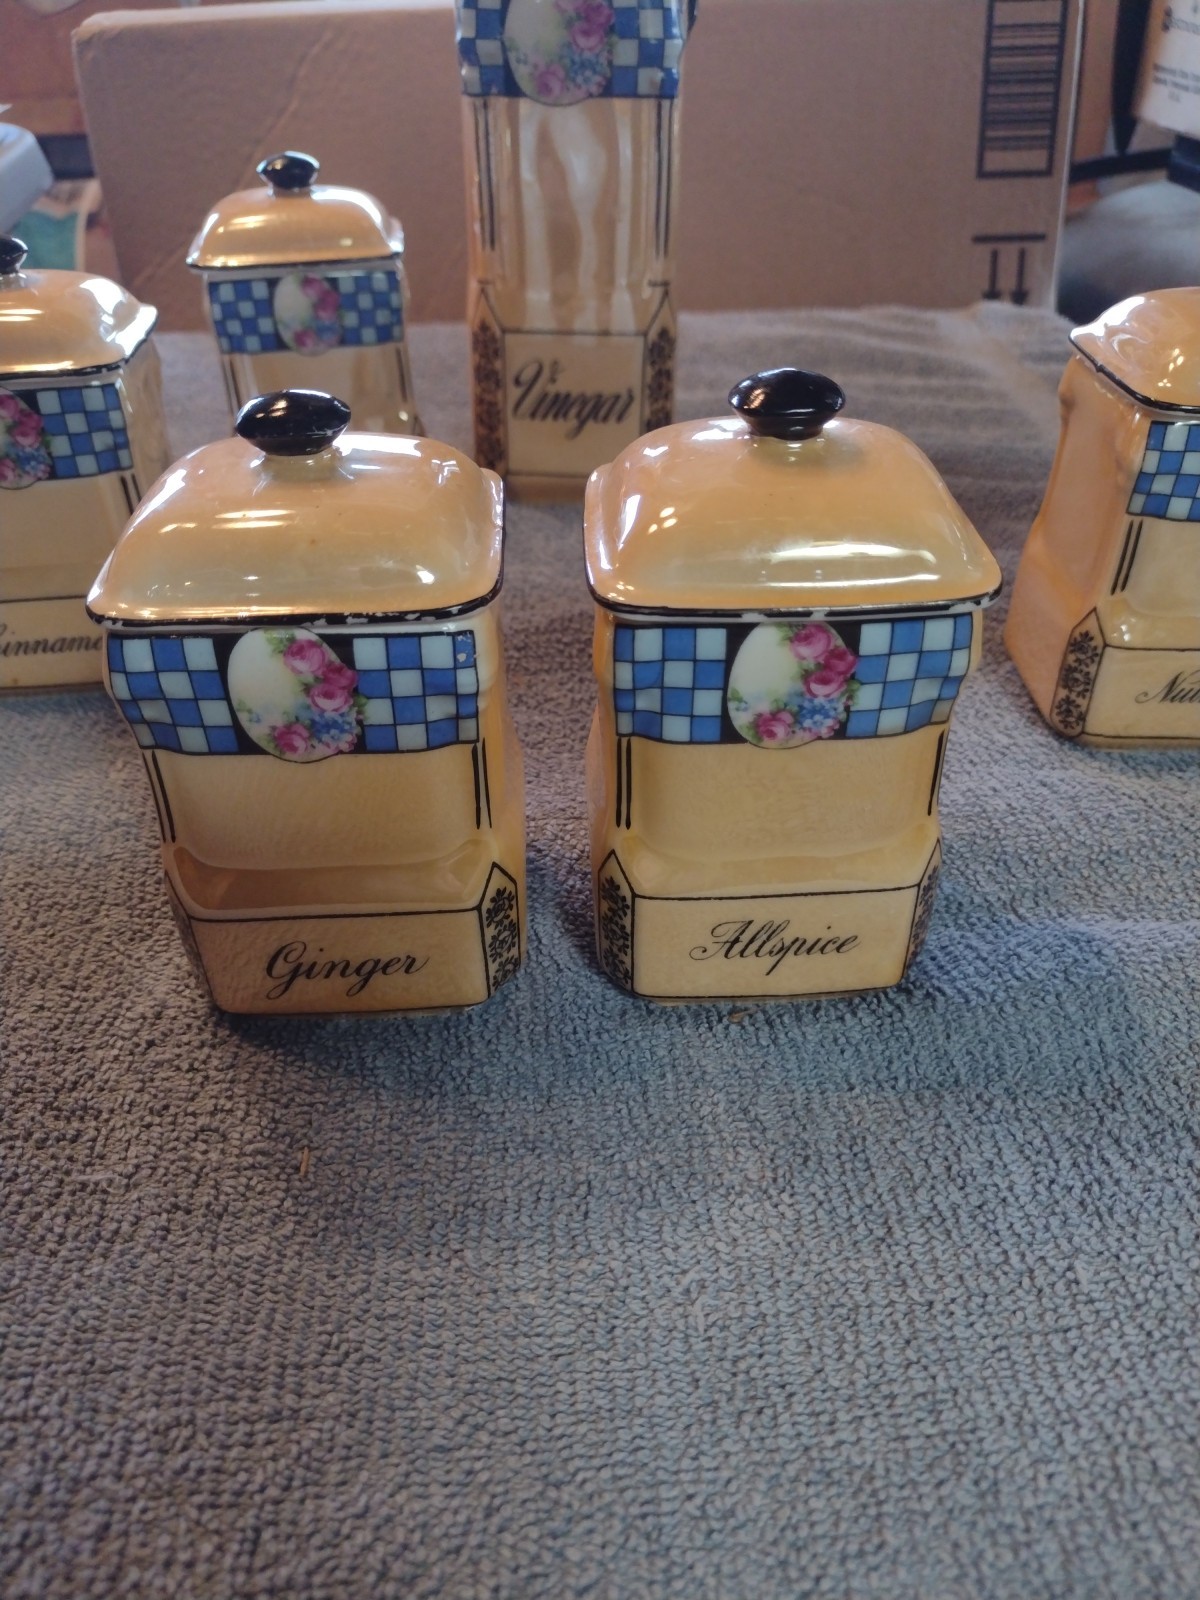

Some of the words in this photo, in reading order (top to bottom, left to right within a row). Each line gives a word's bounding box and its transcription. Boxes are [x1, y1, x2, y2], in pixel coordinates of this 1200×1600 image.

[511, 358, 634, 440] Vinegar
[265, 941, 430, 1001] Ginger
[689, 919, 861, 976] Allspice
